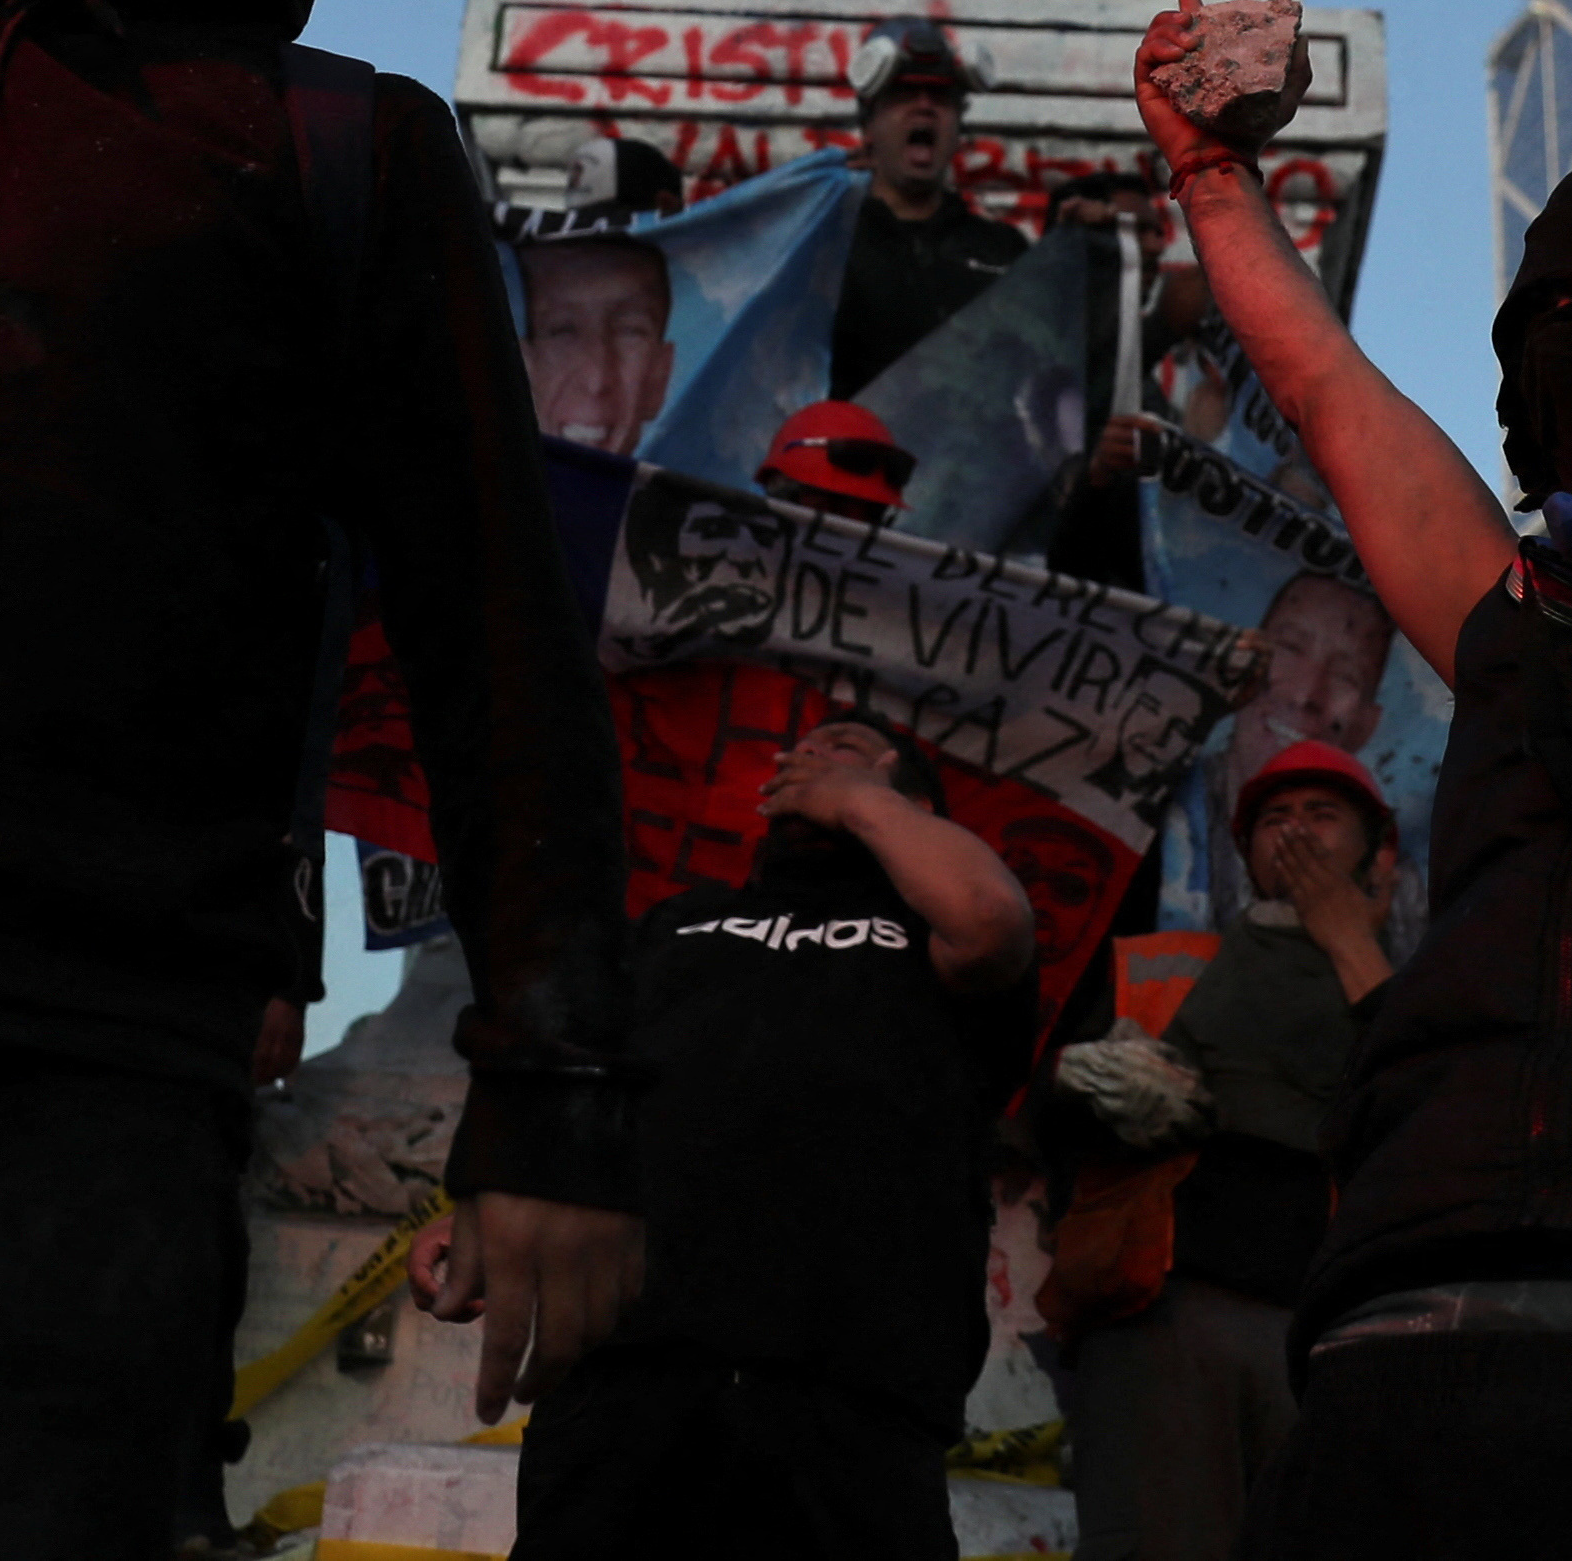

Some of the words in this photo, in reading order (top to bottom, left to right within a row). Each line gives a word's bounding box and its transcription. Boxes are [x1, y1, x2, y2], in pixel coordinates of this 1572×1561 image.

[791, 560, 882, 657] DE
[908, 582, 1122, 729] VIVIR
[911, 683, 1095, 800] PAZ
